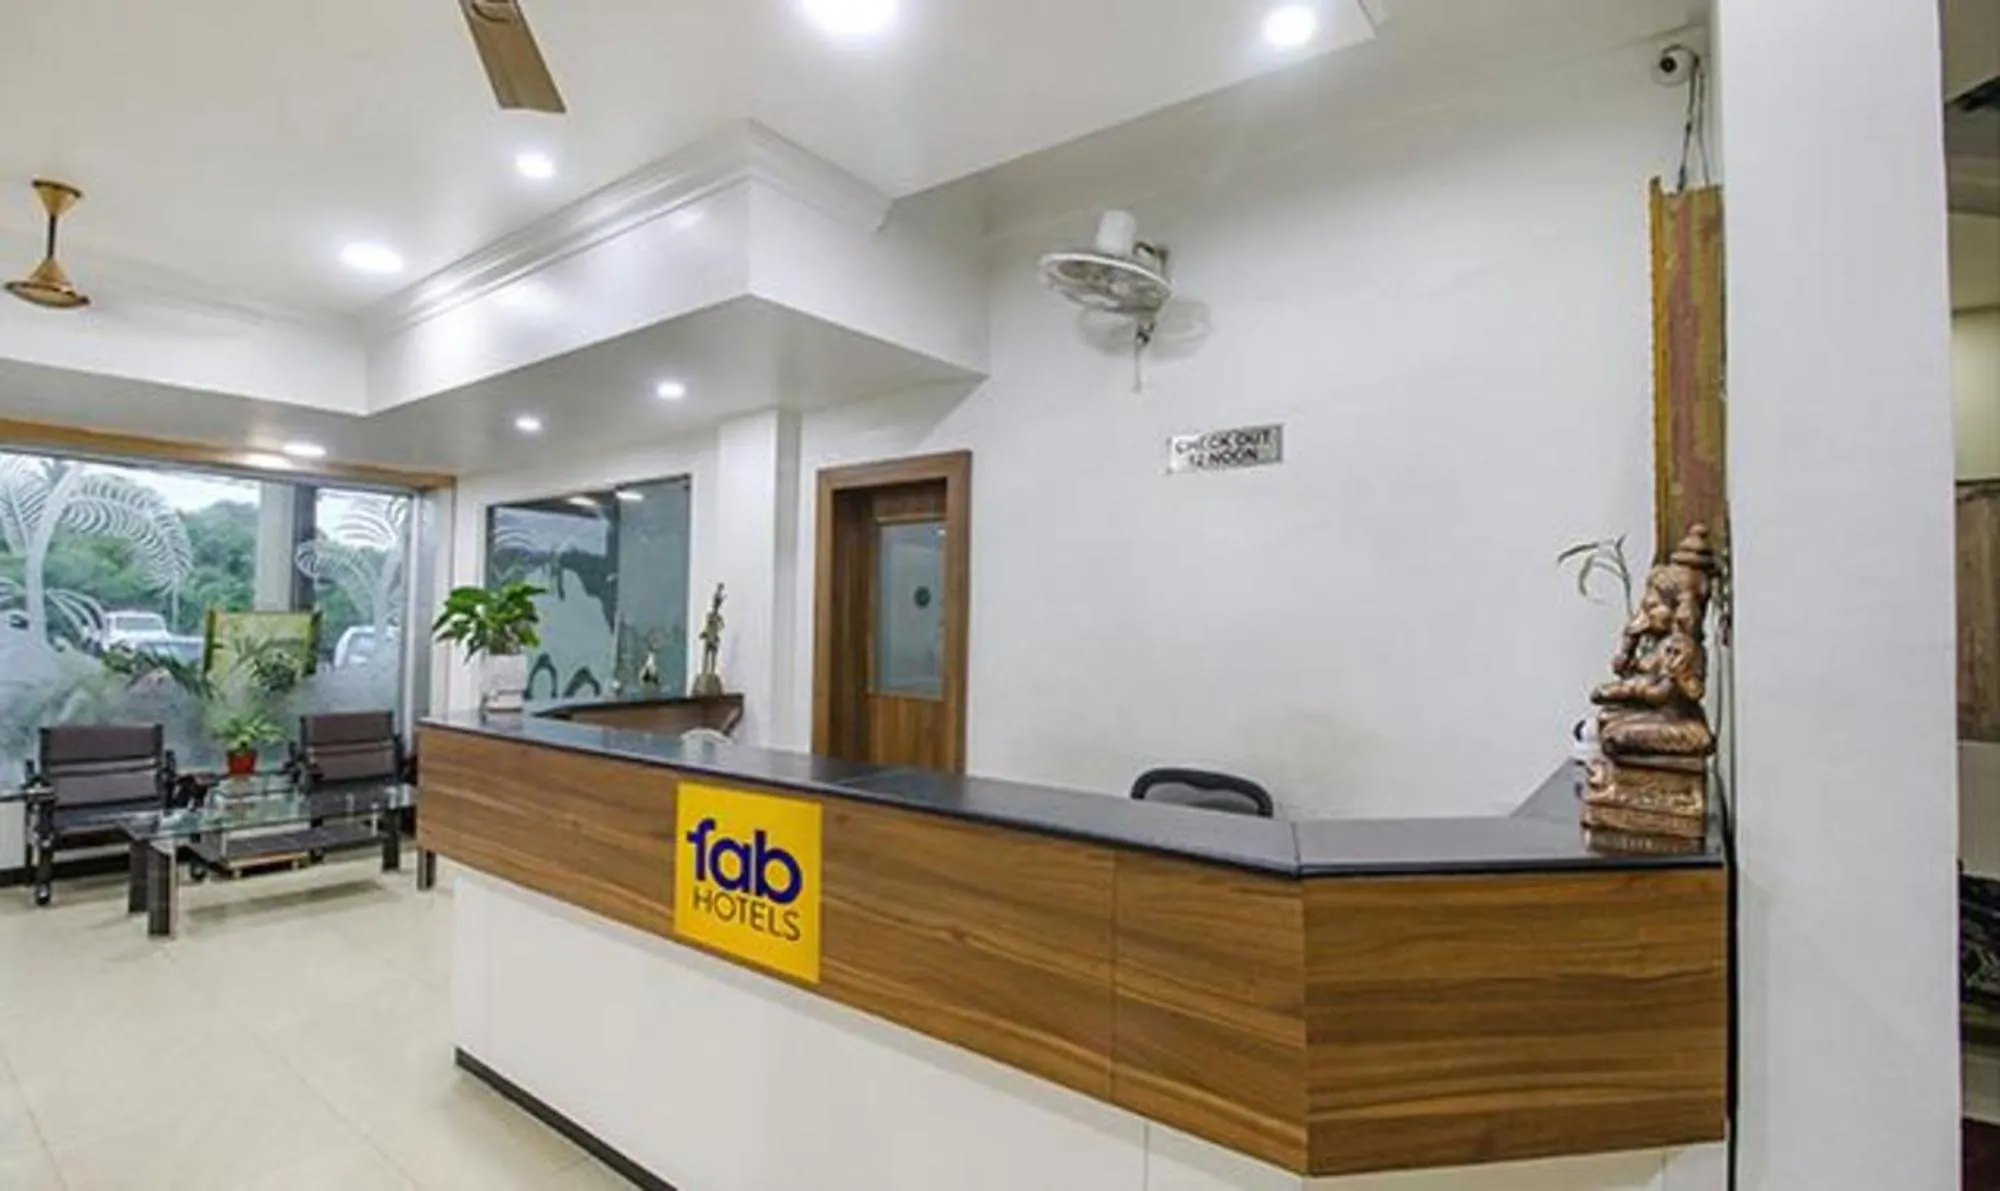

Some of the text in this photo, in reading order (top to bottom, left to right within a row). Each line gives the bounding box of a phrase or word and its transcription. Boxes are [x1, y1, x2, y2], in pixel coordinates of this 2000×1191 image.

[1175, 428, 1271, 454] CHECK OUT
[1208, 448, 1258, 466] NOON
[686, 818, 803, 905] fab
[692, 886, 801, 942] HOTELS
